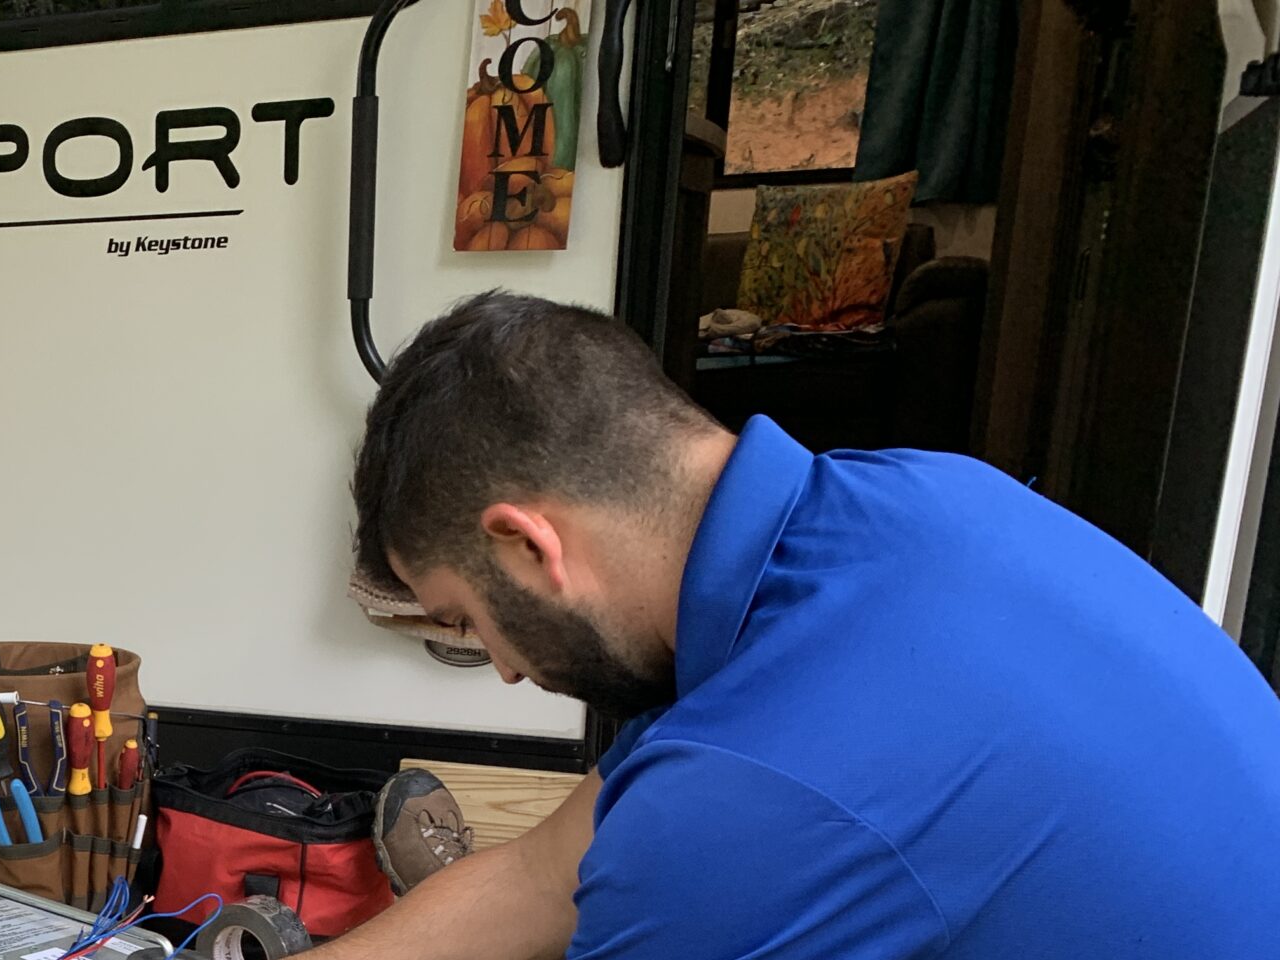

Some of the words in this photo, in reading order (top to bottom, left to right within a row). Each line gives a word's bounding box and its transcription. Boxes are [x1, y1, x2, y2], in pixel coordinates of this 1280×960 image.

[107, 238, 131, 257] by
[135, 235, 229, 255] Keystone
[92, 674, 105, 698] wiha
